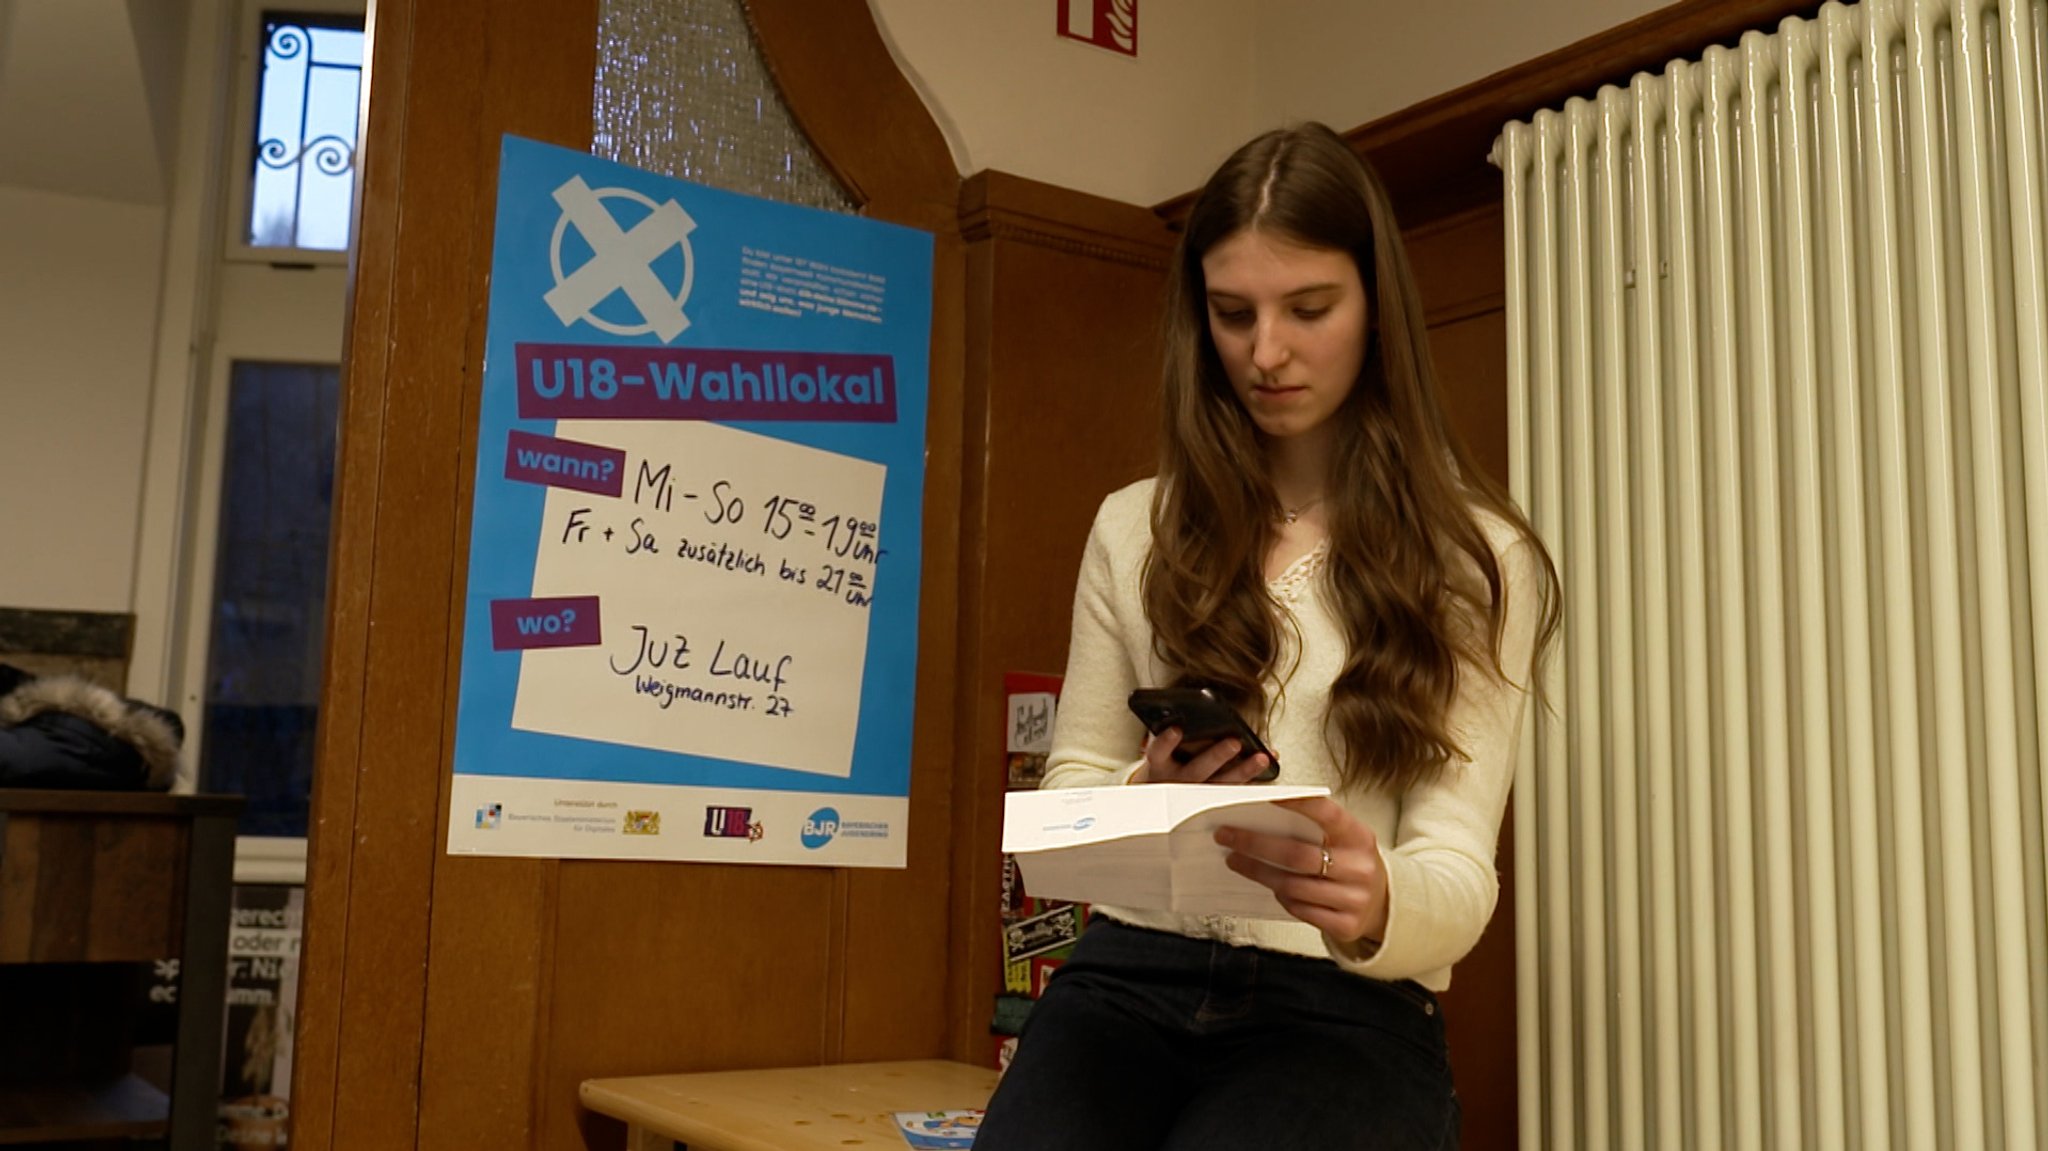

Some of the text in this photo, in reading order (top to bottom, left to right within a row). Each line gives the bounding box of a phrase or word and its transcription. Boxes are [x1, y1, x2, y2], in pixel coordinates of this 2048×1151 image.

[531, 358, 884, 404] U18-Wahllokal
[516, 447, 615, 481] wann?
[562, 508, 592, 544] Fr
[625, 517, 659, 554] Sa
[677, 536, 766, 577] zusätzlich
[779, 559, 807, 585] bis
[516, 609, 577, 635] wo?
[709, 640, 792, 692] Lauf
[635, 675, 794, 718] Weigmannstr. 27
[804, 820, 836, 836] BJR
[233, 932, 283, 951] oder
